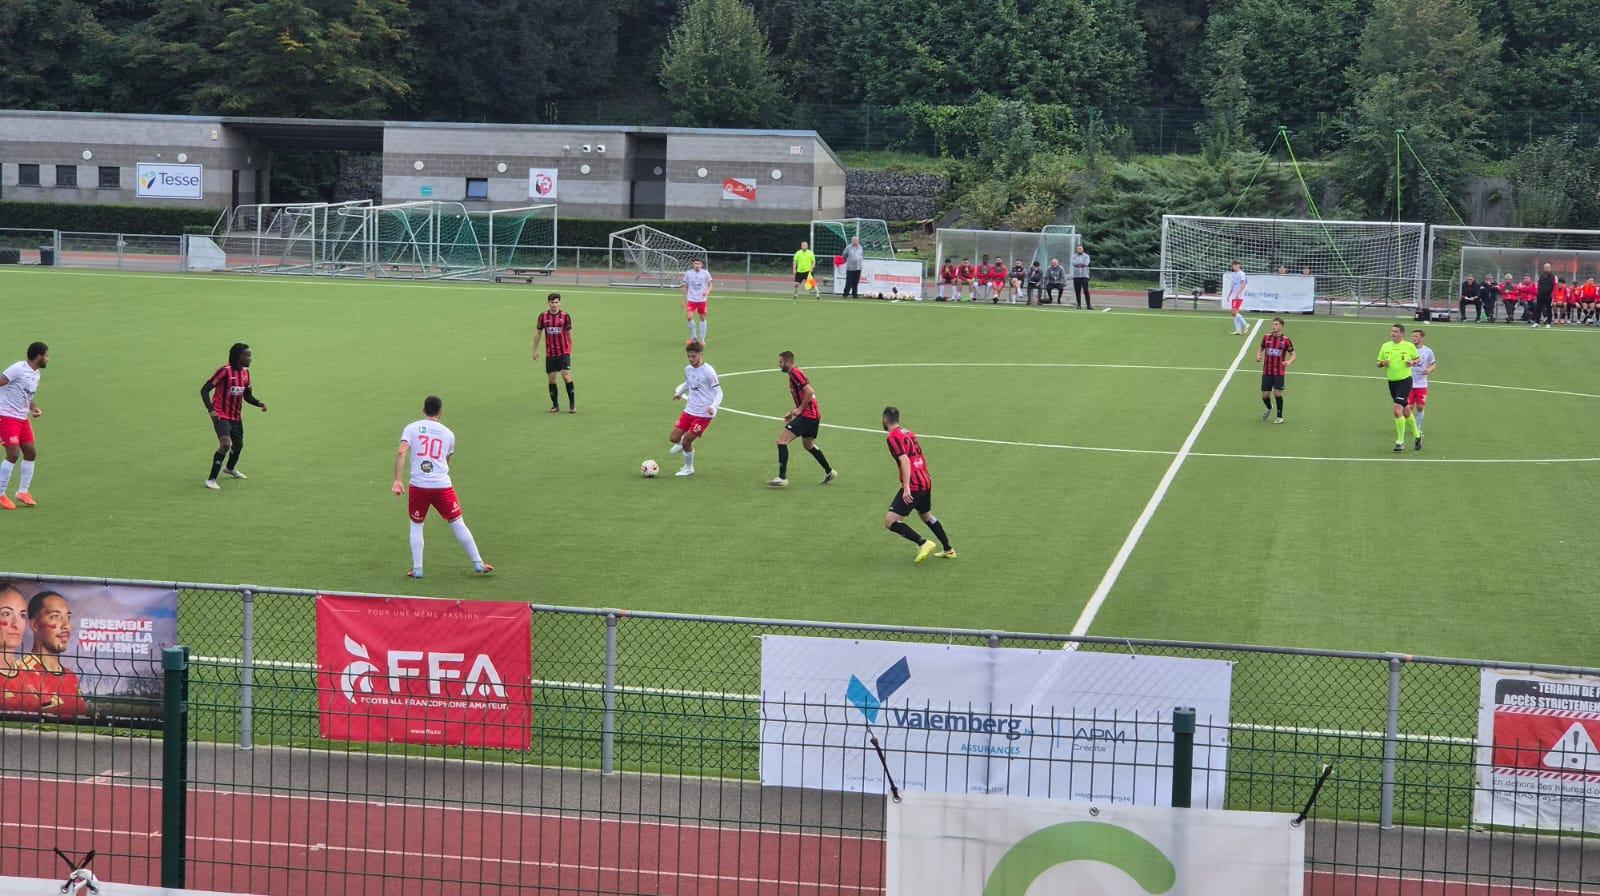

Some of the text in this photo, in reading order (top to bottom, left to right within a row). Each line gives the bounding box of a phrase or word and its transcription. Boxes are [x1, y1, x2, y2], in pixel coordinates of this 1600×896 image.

[158, 172, 200, 186] Tesse
[416, 434, 442, 460] 30
[903, 436, 922, 458] 25
[442, 612, 480, 620] PASSION
[80, 618, 153, 632] ENSEMBLE
[78, 629, 153, 643] CONTRE LA
[81, 641, 149, 655] VIOLENCE
[387, 650, 509, 698] FFA
[1539, 682, 1581, 697] TERRAIN
[1582, 686, 1594, 698] DE
[1503, 694, 1537, 708] ACCÈS
[893, 706, 1022, 741] Valemberg
[1073, 727, 1126, 744] APM
[960, 742, 1021, 756] ASSURANCES
